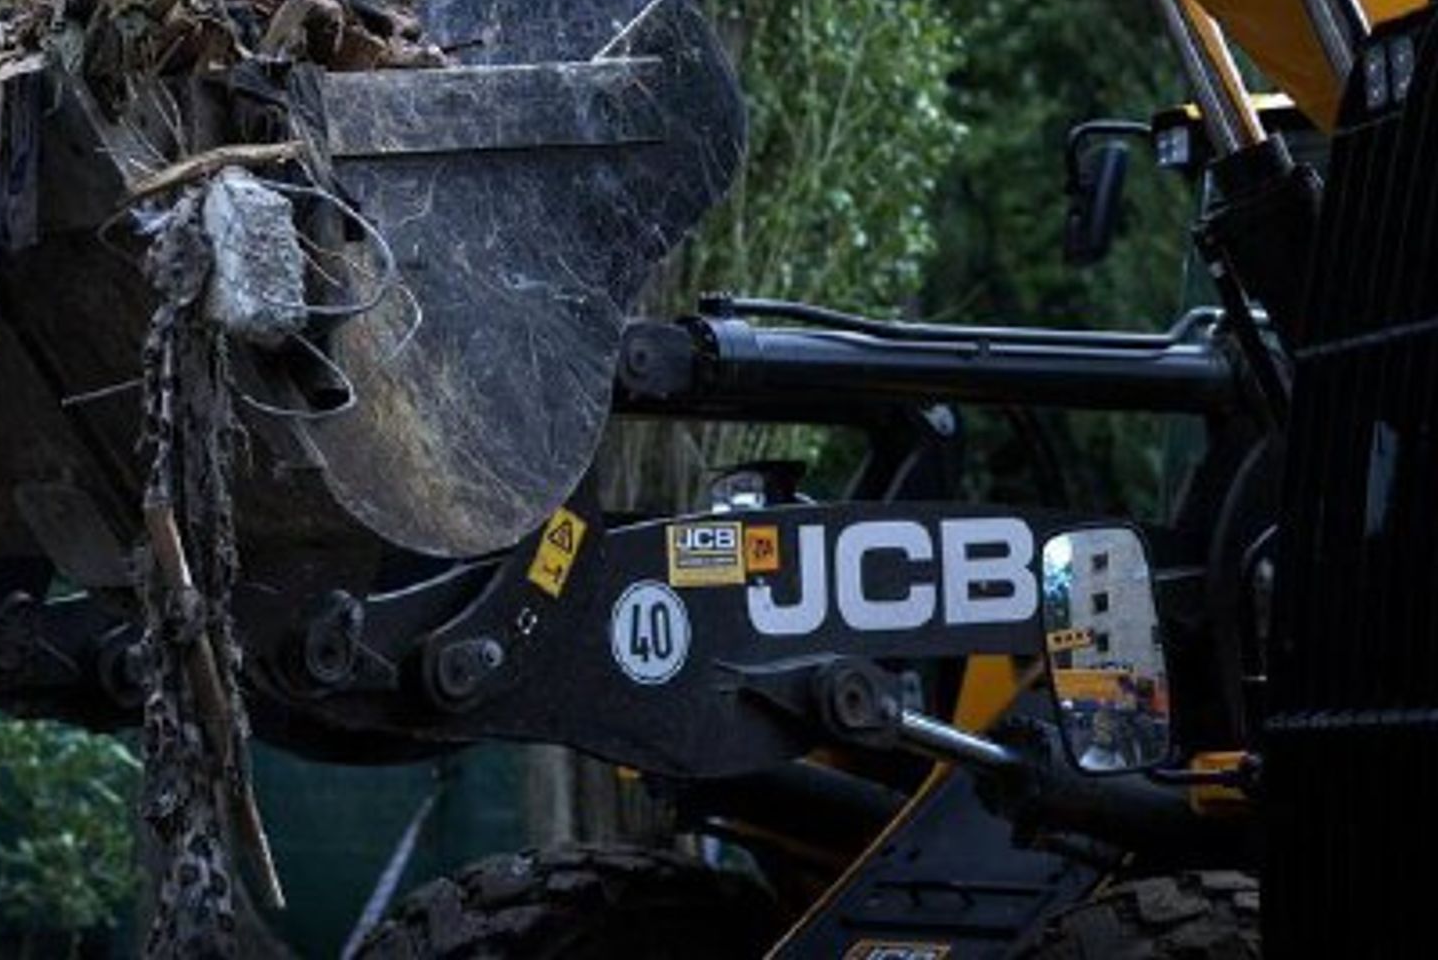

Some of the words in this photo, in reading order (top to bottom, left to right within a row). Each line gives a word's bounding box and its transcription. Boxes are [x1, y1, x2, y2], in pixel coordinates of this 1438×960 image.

[676, 527, 736, 548] JCB
[747, 518, 1038, 634] JCB
[630, 601, 672, 662] 40
